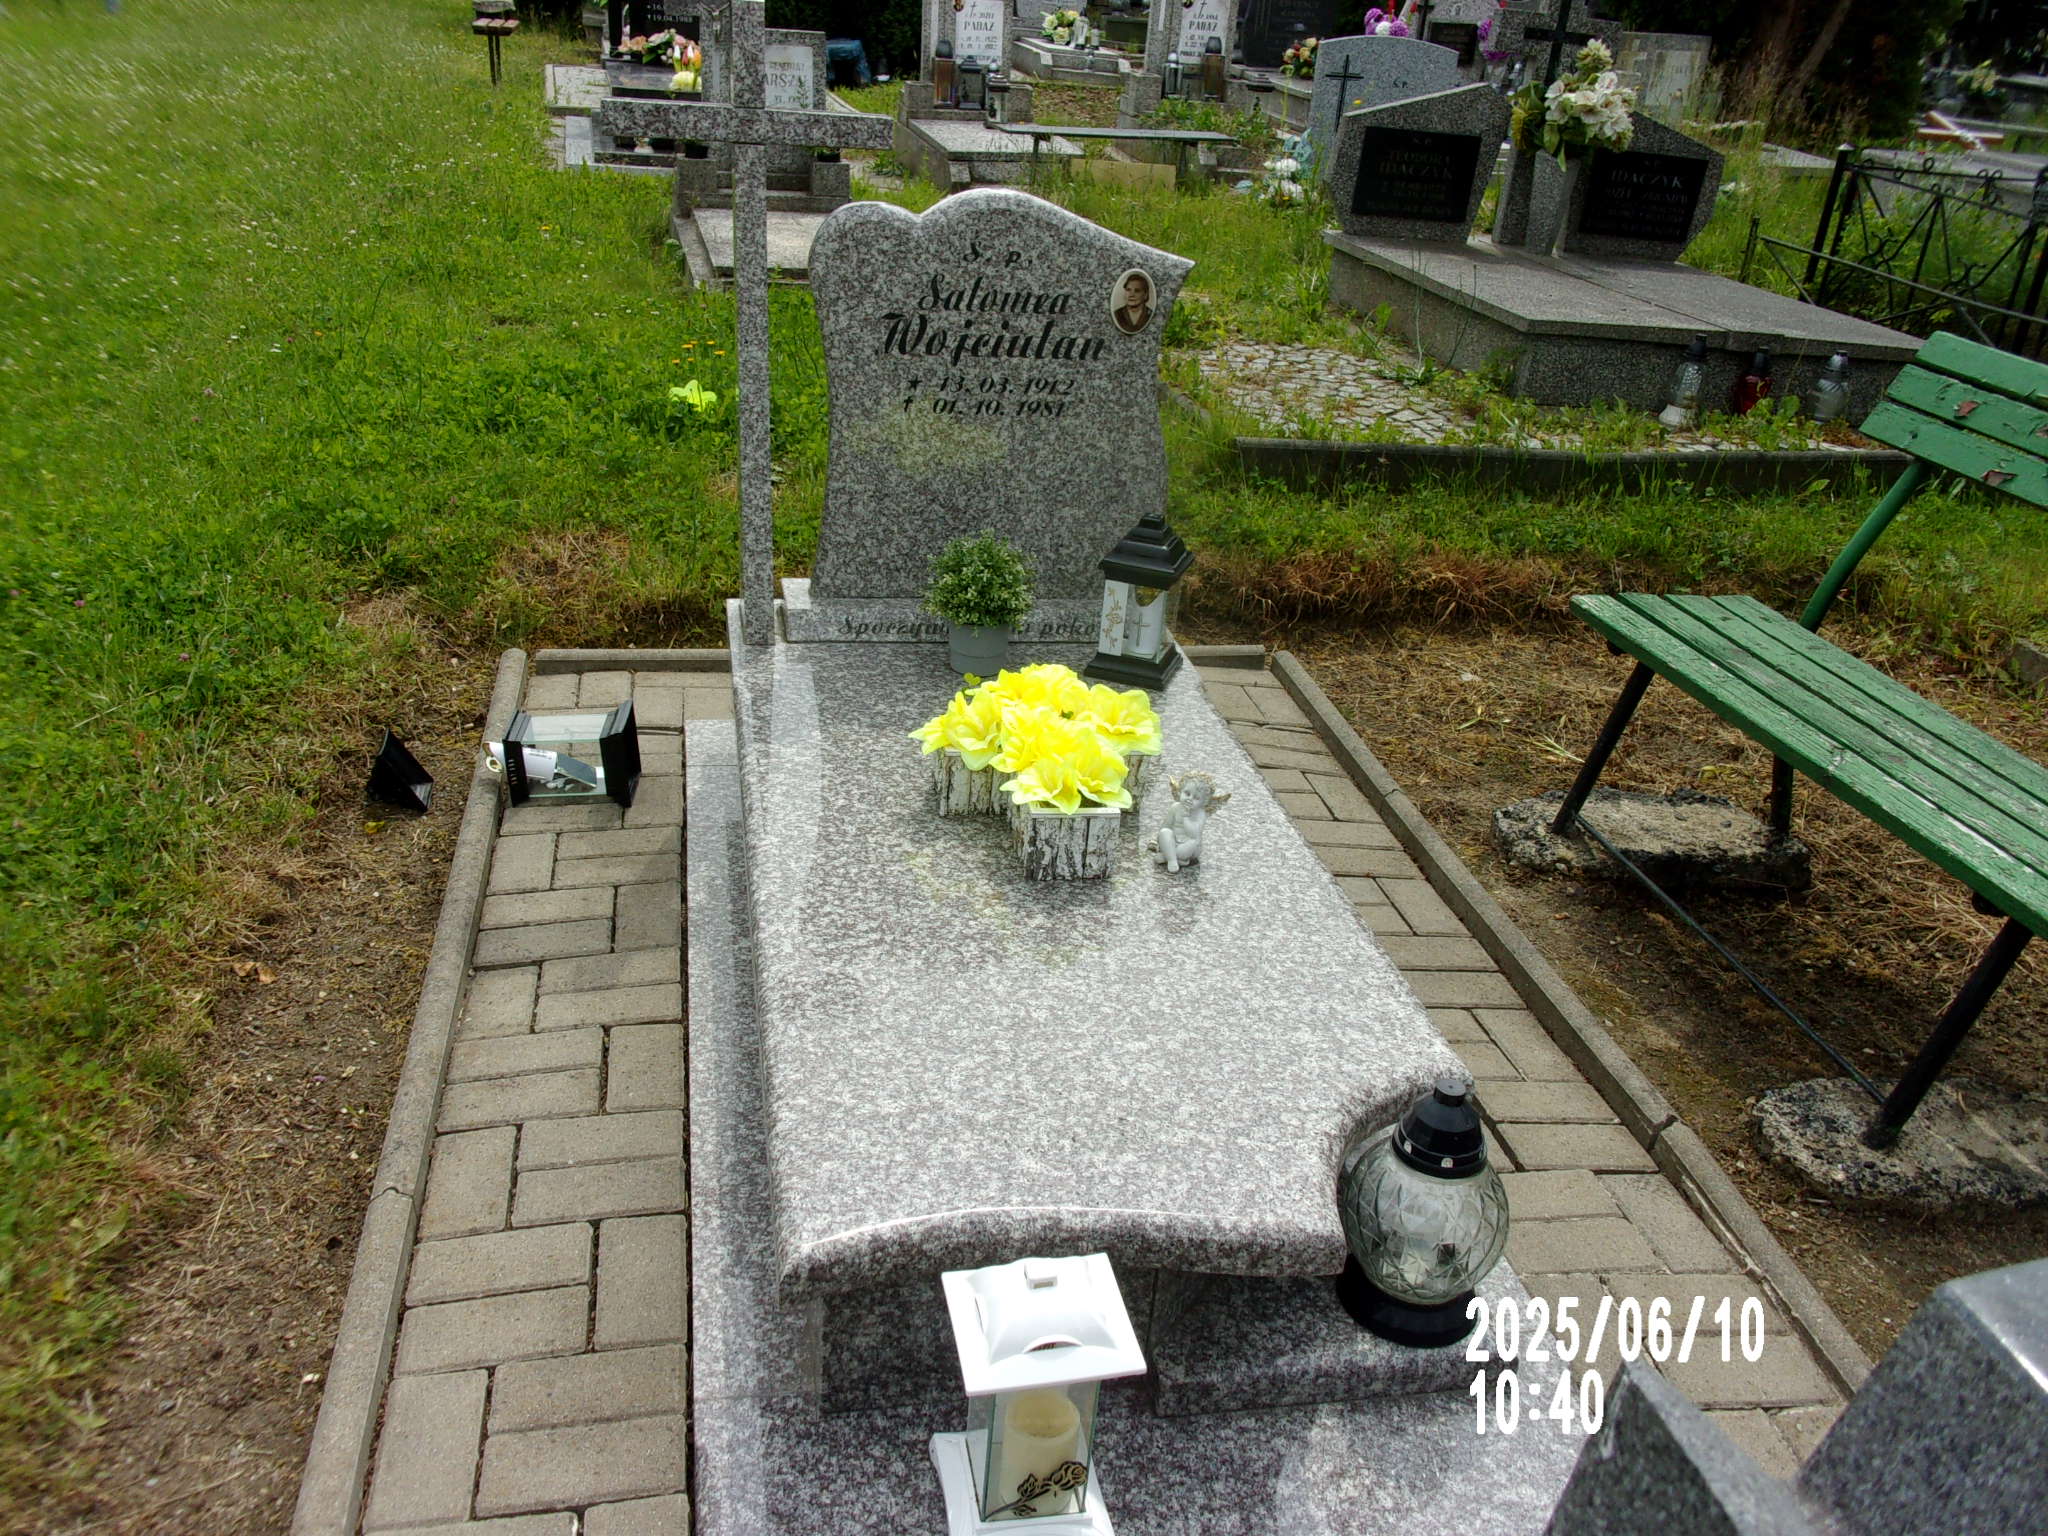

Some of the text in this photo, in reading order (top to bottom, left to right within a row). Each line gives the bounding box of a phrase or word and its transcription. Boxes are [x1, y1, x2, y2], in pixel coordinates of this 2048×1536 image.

[918, 273, 1072, 314] Salomea
[881, 312, 1106, 367] Wojciulan
[1024, 377, 1076, 396] 1912
